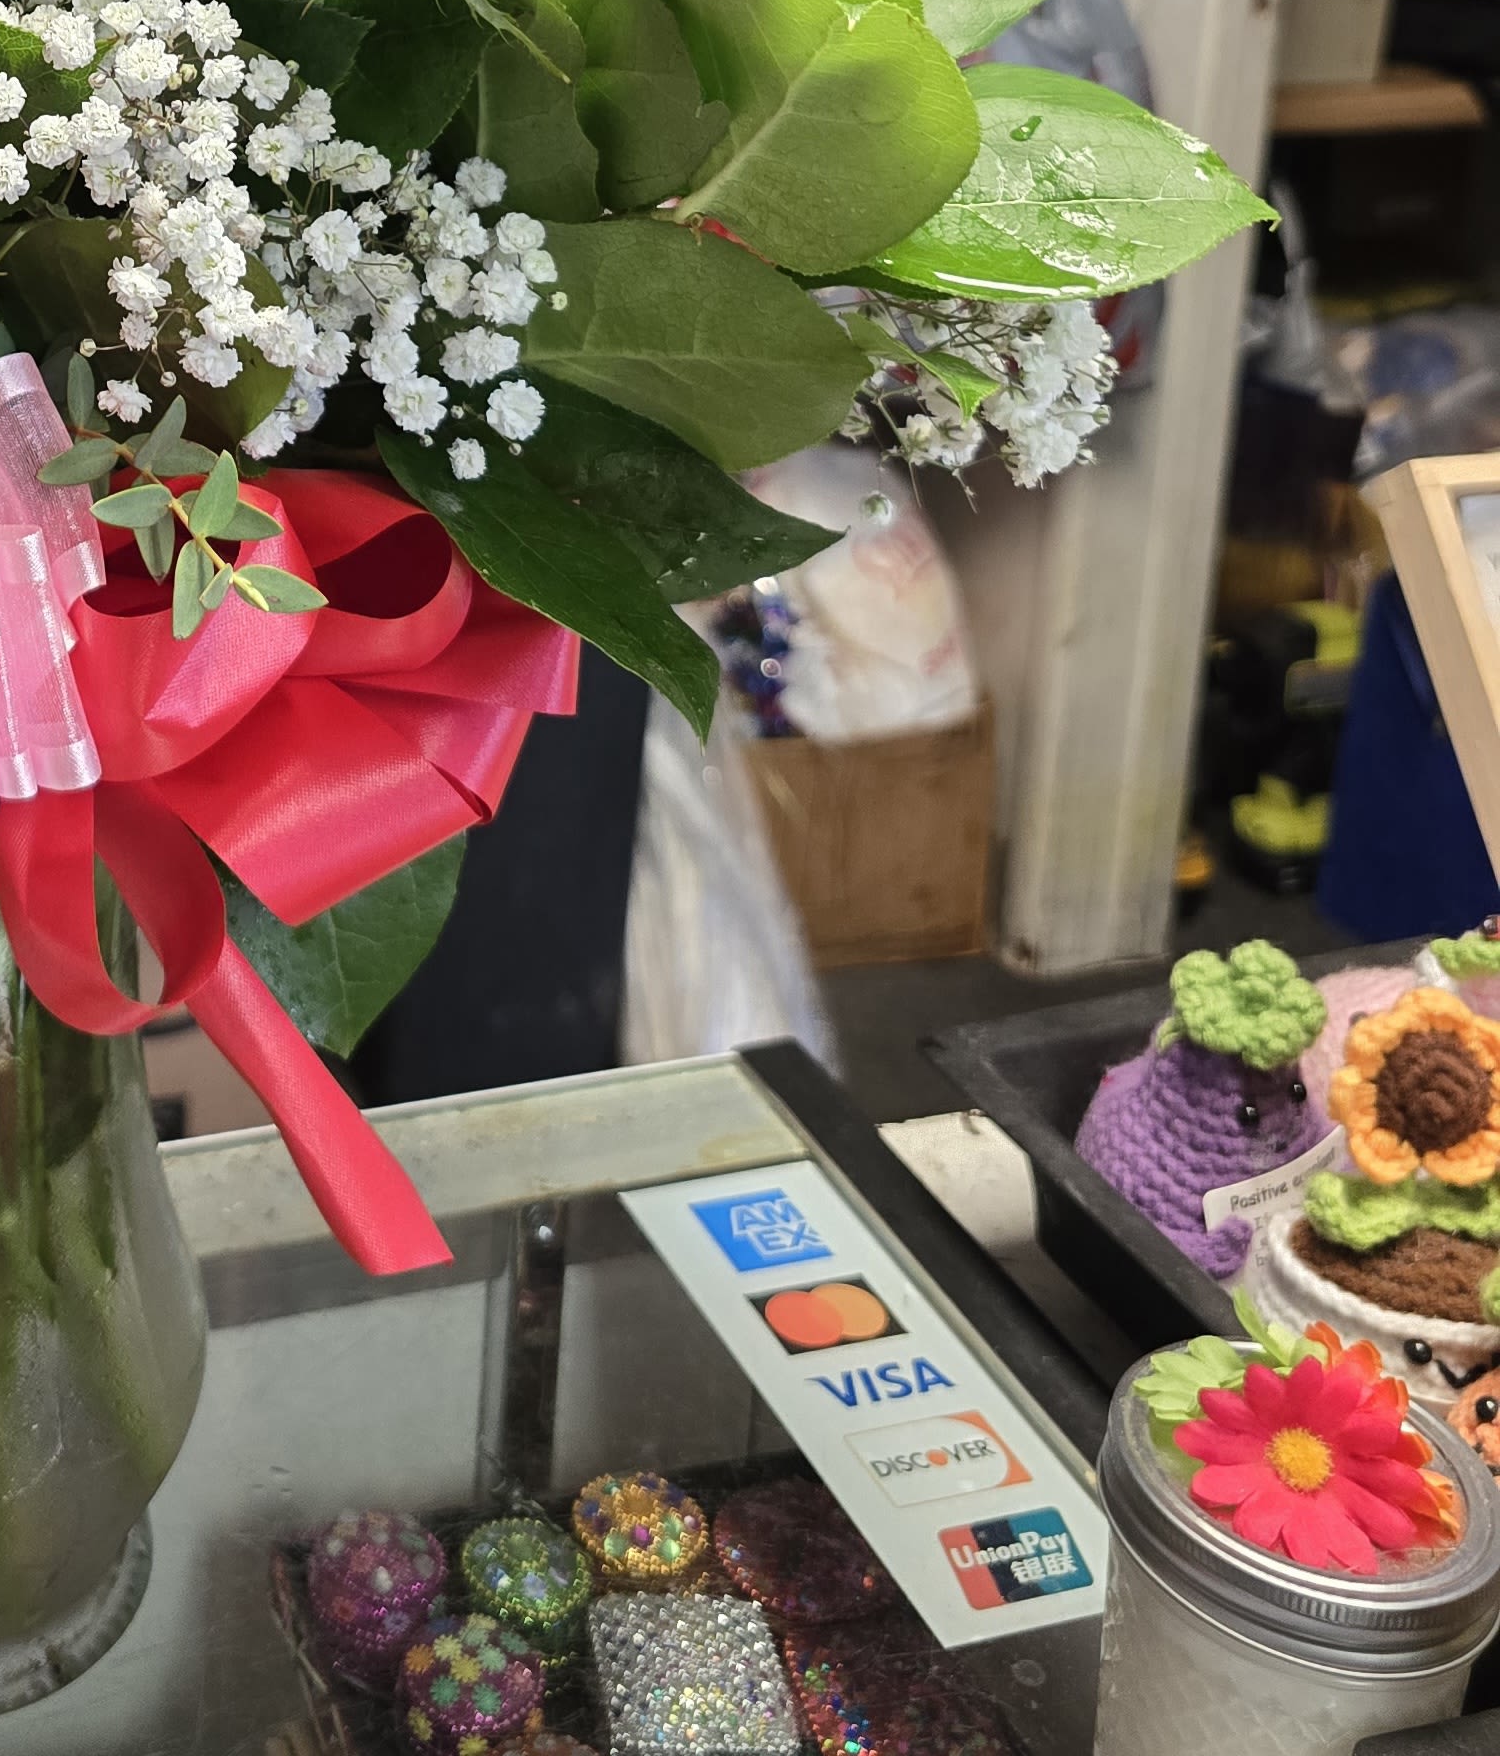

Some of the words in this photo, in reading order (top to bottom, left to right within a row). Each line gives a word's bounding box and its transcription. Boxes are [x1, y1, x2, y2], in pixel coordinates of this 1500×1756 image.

[1230, 1182, 1288, 1213] Positive
[731, 1198, 805, 1235] AM
[748, 1222, 822, 1255] EX
[804, 1357, 955, 1407] VISA
[870, 1438, 996, 1478] DISCOVER
[951, 1531, 1069, 1568] UnionPay
